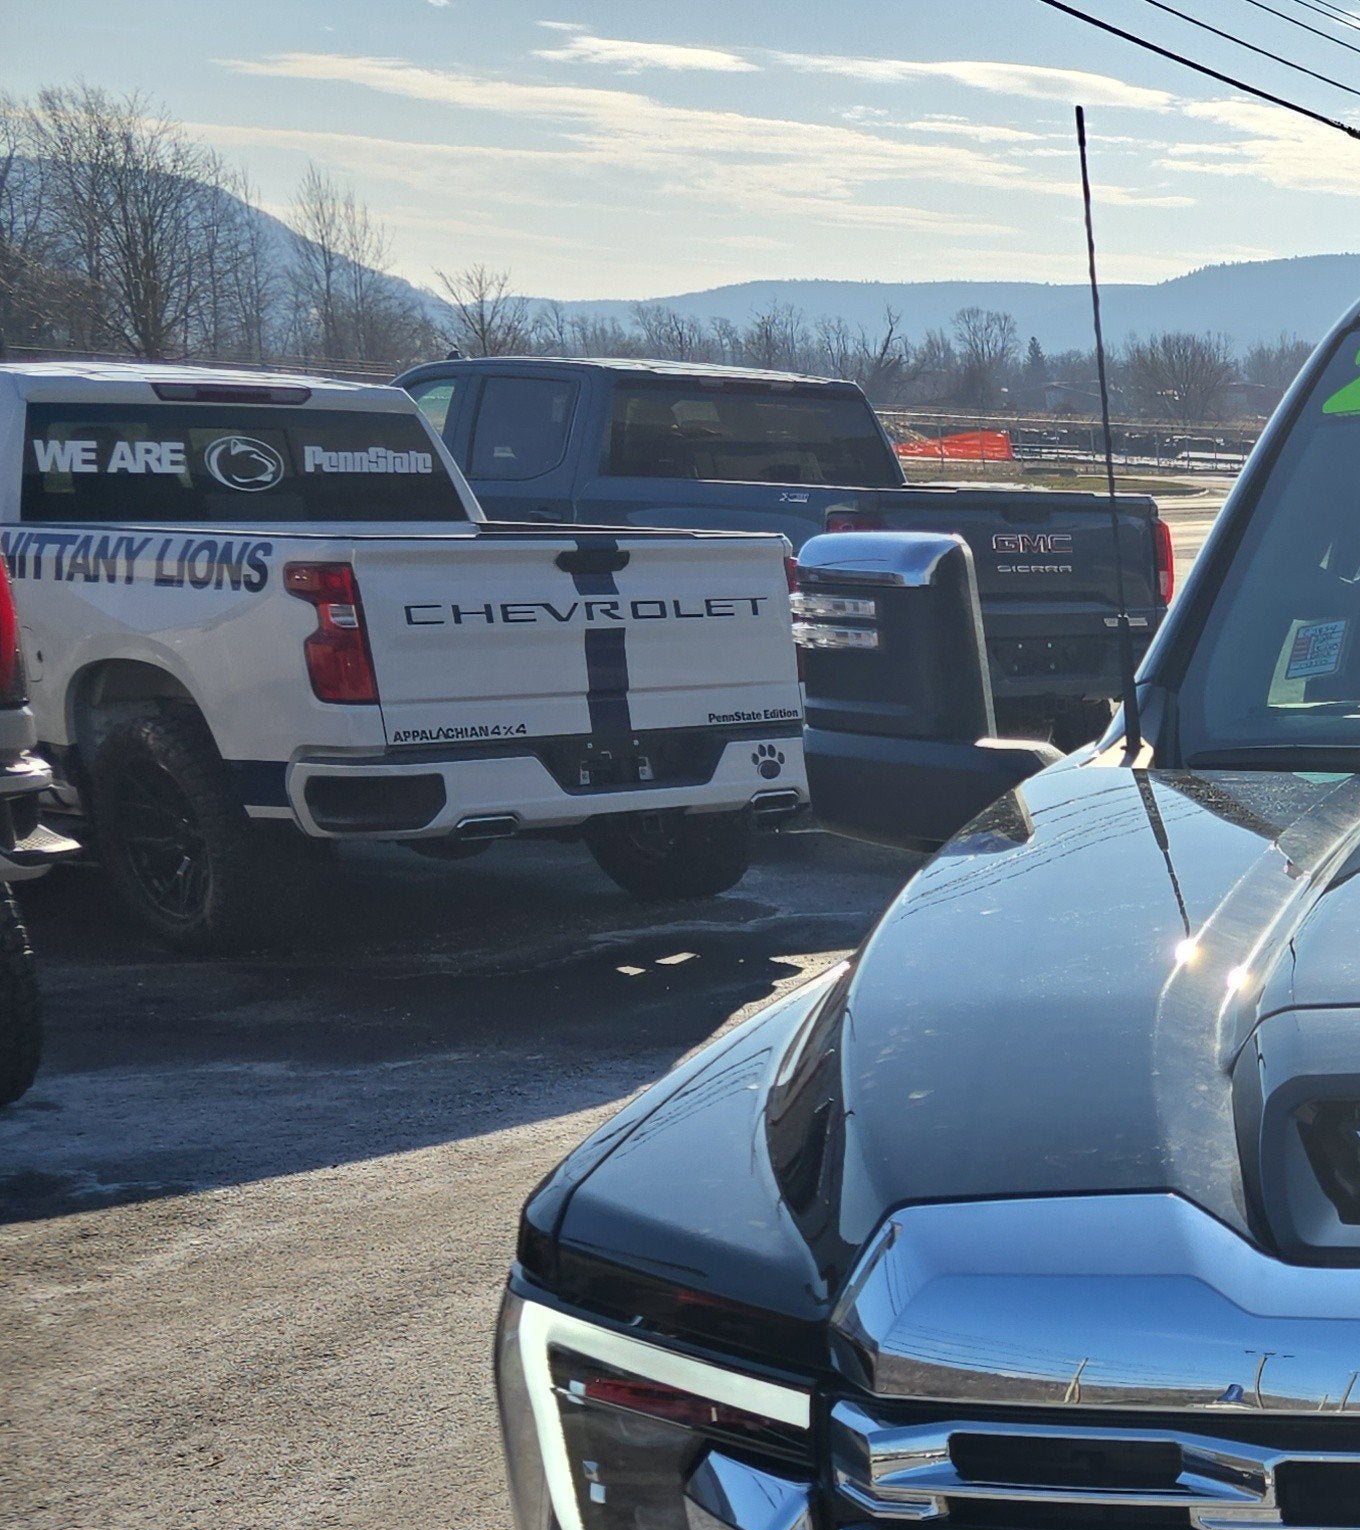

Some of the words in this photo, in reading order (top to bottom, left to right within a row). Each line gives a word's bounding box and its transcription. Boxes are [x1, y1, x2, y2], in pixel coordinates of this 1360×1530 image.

[33, 439, 98, 472] WE
[106, 440, 186, 473] ARE
[303, 445, 433, 474] PennState
[992, 533, 1073, 553] GMC
[0, 531, 153, 585] NITTANY
[154, 538, 273, 593] LIONS
[997, 564, 1072, 573] SIERRA
[404, 597, 768, 626] CHEVROLET
[708, 706, 762, 723] PennState
[763, 703, 799, 720] Edition
